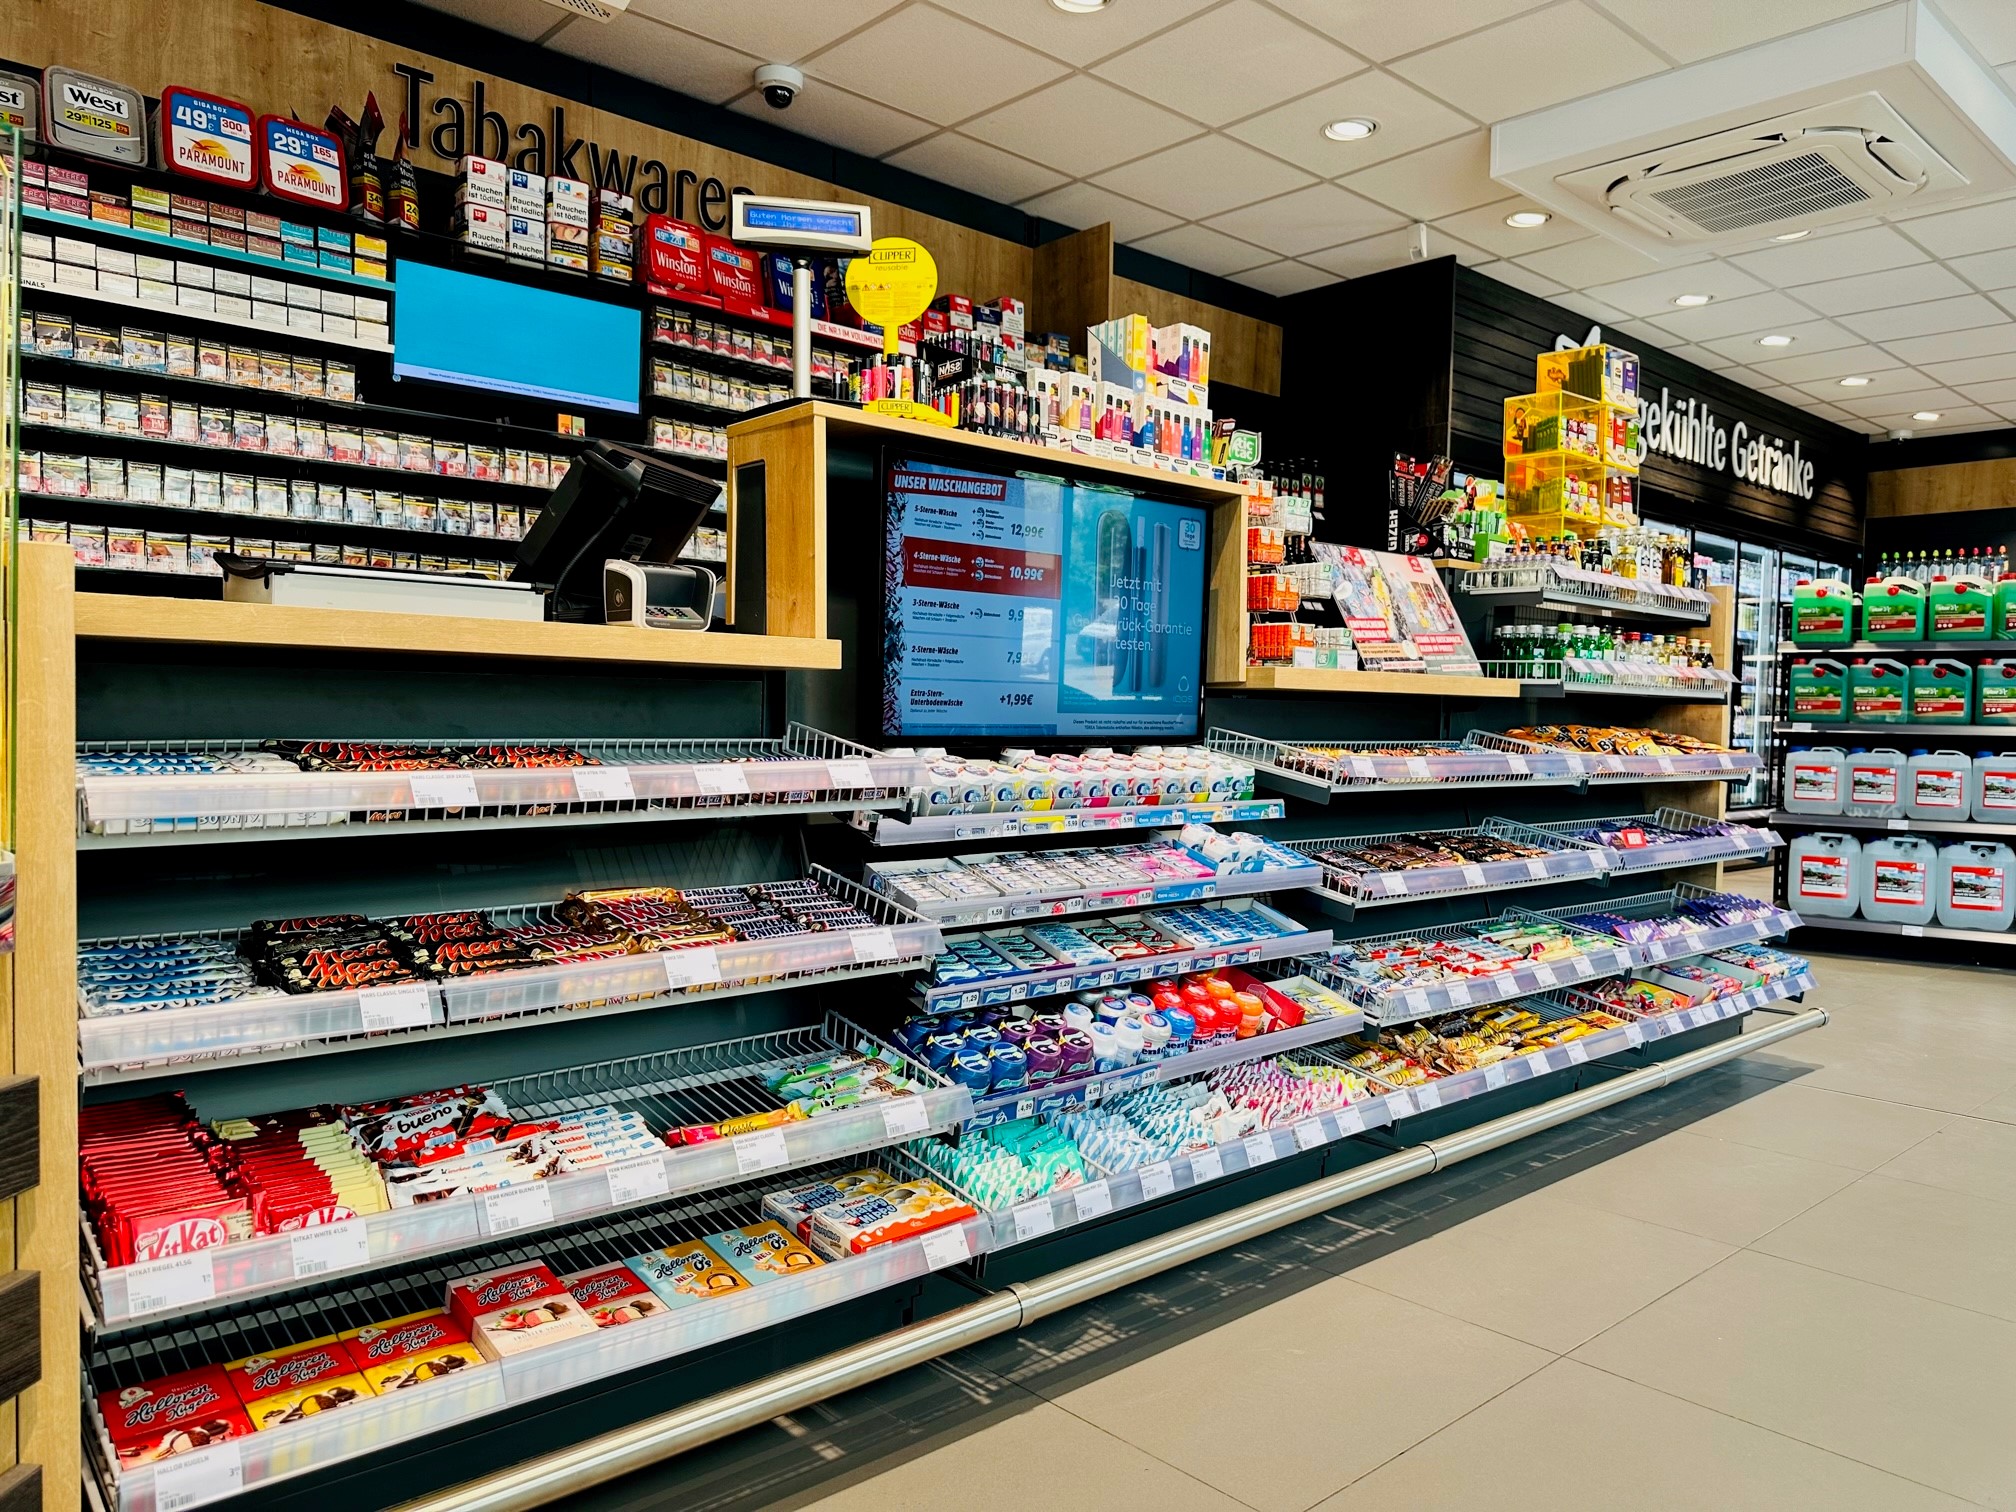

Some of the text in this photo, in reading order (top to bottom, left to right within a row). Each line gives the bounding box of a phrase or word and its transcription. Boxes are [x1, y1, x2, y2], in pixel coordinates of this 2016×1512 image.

[67, 85, 124, 116] West
[193, 99, 228, 115] GIGA BOX
[222, 118, 243, 133] 300
[313, 144, 332, 159] 165
[393, 61, 756, 236] Tabakware
[179, 146, 246, 175] PARAMOUNT
[61, 170, 87, 182] TEREA
[277, 169, 337, 198] PARAMOUNT
[468, 190, 505, 206] ist tödlich
[470, 182, 504, 198] Rauchen
[62, 197, 88, 209] TEREA
[182, 197, 206, 209] TEREA
[512, 195, 545, 211] Rauchen
[556, 201, 588, 217] Rauchen
[220, 205, 244, 218] TEREA
[510, 204, 546, 219] ist tödlich
[553, 209, 589, 225] ist tödlich
[183, 223, 207, 235] TEREA
[221, 230, 245, 243] TEREA
[471, 230, 505, 246] Rauchen
[512, 241, 545, 258] Rauchen
[872, 251, 912, 261] CLIPPER
[655, 248, 698, 278] Winston
[712, 267, 752, 296] Winston
[878, 401, 913, 413] CLIPPER
[1638, 386, 1815, 500] gekühlte Getränke
[894, 474, 1004, 497] UNSER WASCHANGEBOT
[914, 504, 958, 518] 5-Sterne-Wäsche
[1010, 522, 1045, 538] 12,99€
[1184, 522, 1196, 534] 30
[1387, 508, 1400, 552] GIZEH
[913, 550, 962, 564] 4-Sterne-Wäsche
[1009, 565, 1044, 582] 10,99€
[1111, 575, 1162, 592] Jetzt mit
[912, 598, 960, 610] 3-Sterne-Wäsche
[1131, 597, 1157, 616] Tage
[911, 645, 959, 656] 2-Sterne-Wäsche
[1115, 639, 1154, 652] testen.
[910, 698, 963, 708] Unterbodenwäsche
[999, 694, 1034, 707] +1,99€
[708, 903, 756, 916] SNICKERS
[990, 907, 1003, 917] 1,59
[1024, 906, 1041, 914] WHITE
[413, 921, 486, 945] Mars
[303, 938, 393, 966] Mars
[436, 938, 517, 964] Mars
[1058, 979, 1071, 989] 1,29
[1102, 973, 1114, 982] 1,29
[361, 988, 416, 999] MARS CLASSIC SINGLE
[964, 994, 978, 1004] 1,29
[1012, 987, 1026, 996] 1,29
[1087, 1086, 1100, 1096] 4,99
[402, 1106, 433, 1120] kinder
[1019, 1103, 1033, 1113] 4,99
[395, 1103, 454, 1135] bueno
[549, 1114, 617, 1135] kinder Riegel
[559, 1109, 592, 1125] Riegel
[549, 1124, 618, 1147] kinder Riegel
[556, 1133, 625, 1157] kinder Riegel
[567, 1142, 637, 1165] kinder Riegel
[620, 1163, 637, 1171] KINDER
[636, 1160, 652, 1168] RIEGEL
[466, 1183, 498, 1196] kinder
[500, 1189, 519, 1199] KINDER
[794, 1184, 838, 1205] Happy
[838, 1197, 870, 1208] kinder
[844, 1199, 890, 1220] Happy
[859, 1205, 898, 1228] Hippo
[292, 1234, 314, 1244] KITKAT
[313, 1229, 333, 1239] WHITE
[732, 1230, 781, 1258] Halloren
[753, 1250, 773, 1263] NEU
[128, 1266, 152, 1278] KITKAT
[151, 1262, 175, 1273] RIEGEL
[653, 1250, 706, 1281] Halloren
[674, 1272, 694, 1285] NEU
[477, 1274, 542, 1308] Halloren
[508, 1280, 550, 1302] Kugeln
[571, 1275, 623, 1304] Halloren
[597, 1281, 633, 1302] Kugeln
[367, 1322, 438, 1360] Halloren
[402, 1328, 447, 1354] Kugeln
[253, 1351, 331, 1392] Halloren
[290, 1359, 339, 1385] Kugeln
[125, 1383, 213, 1429] Halloren
[166, 1390, 221, 1423] Kugeln
[183, 1455, 210, 1469] KUGELN
